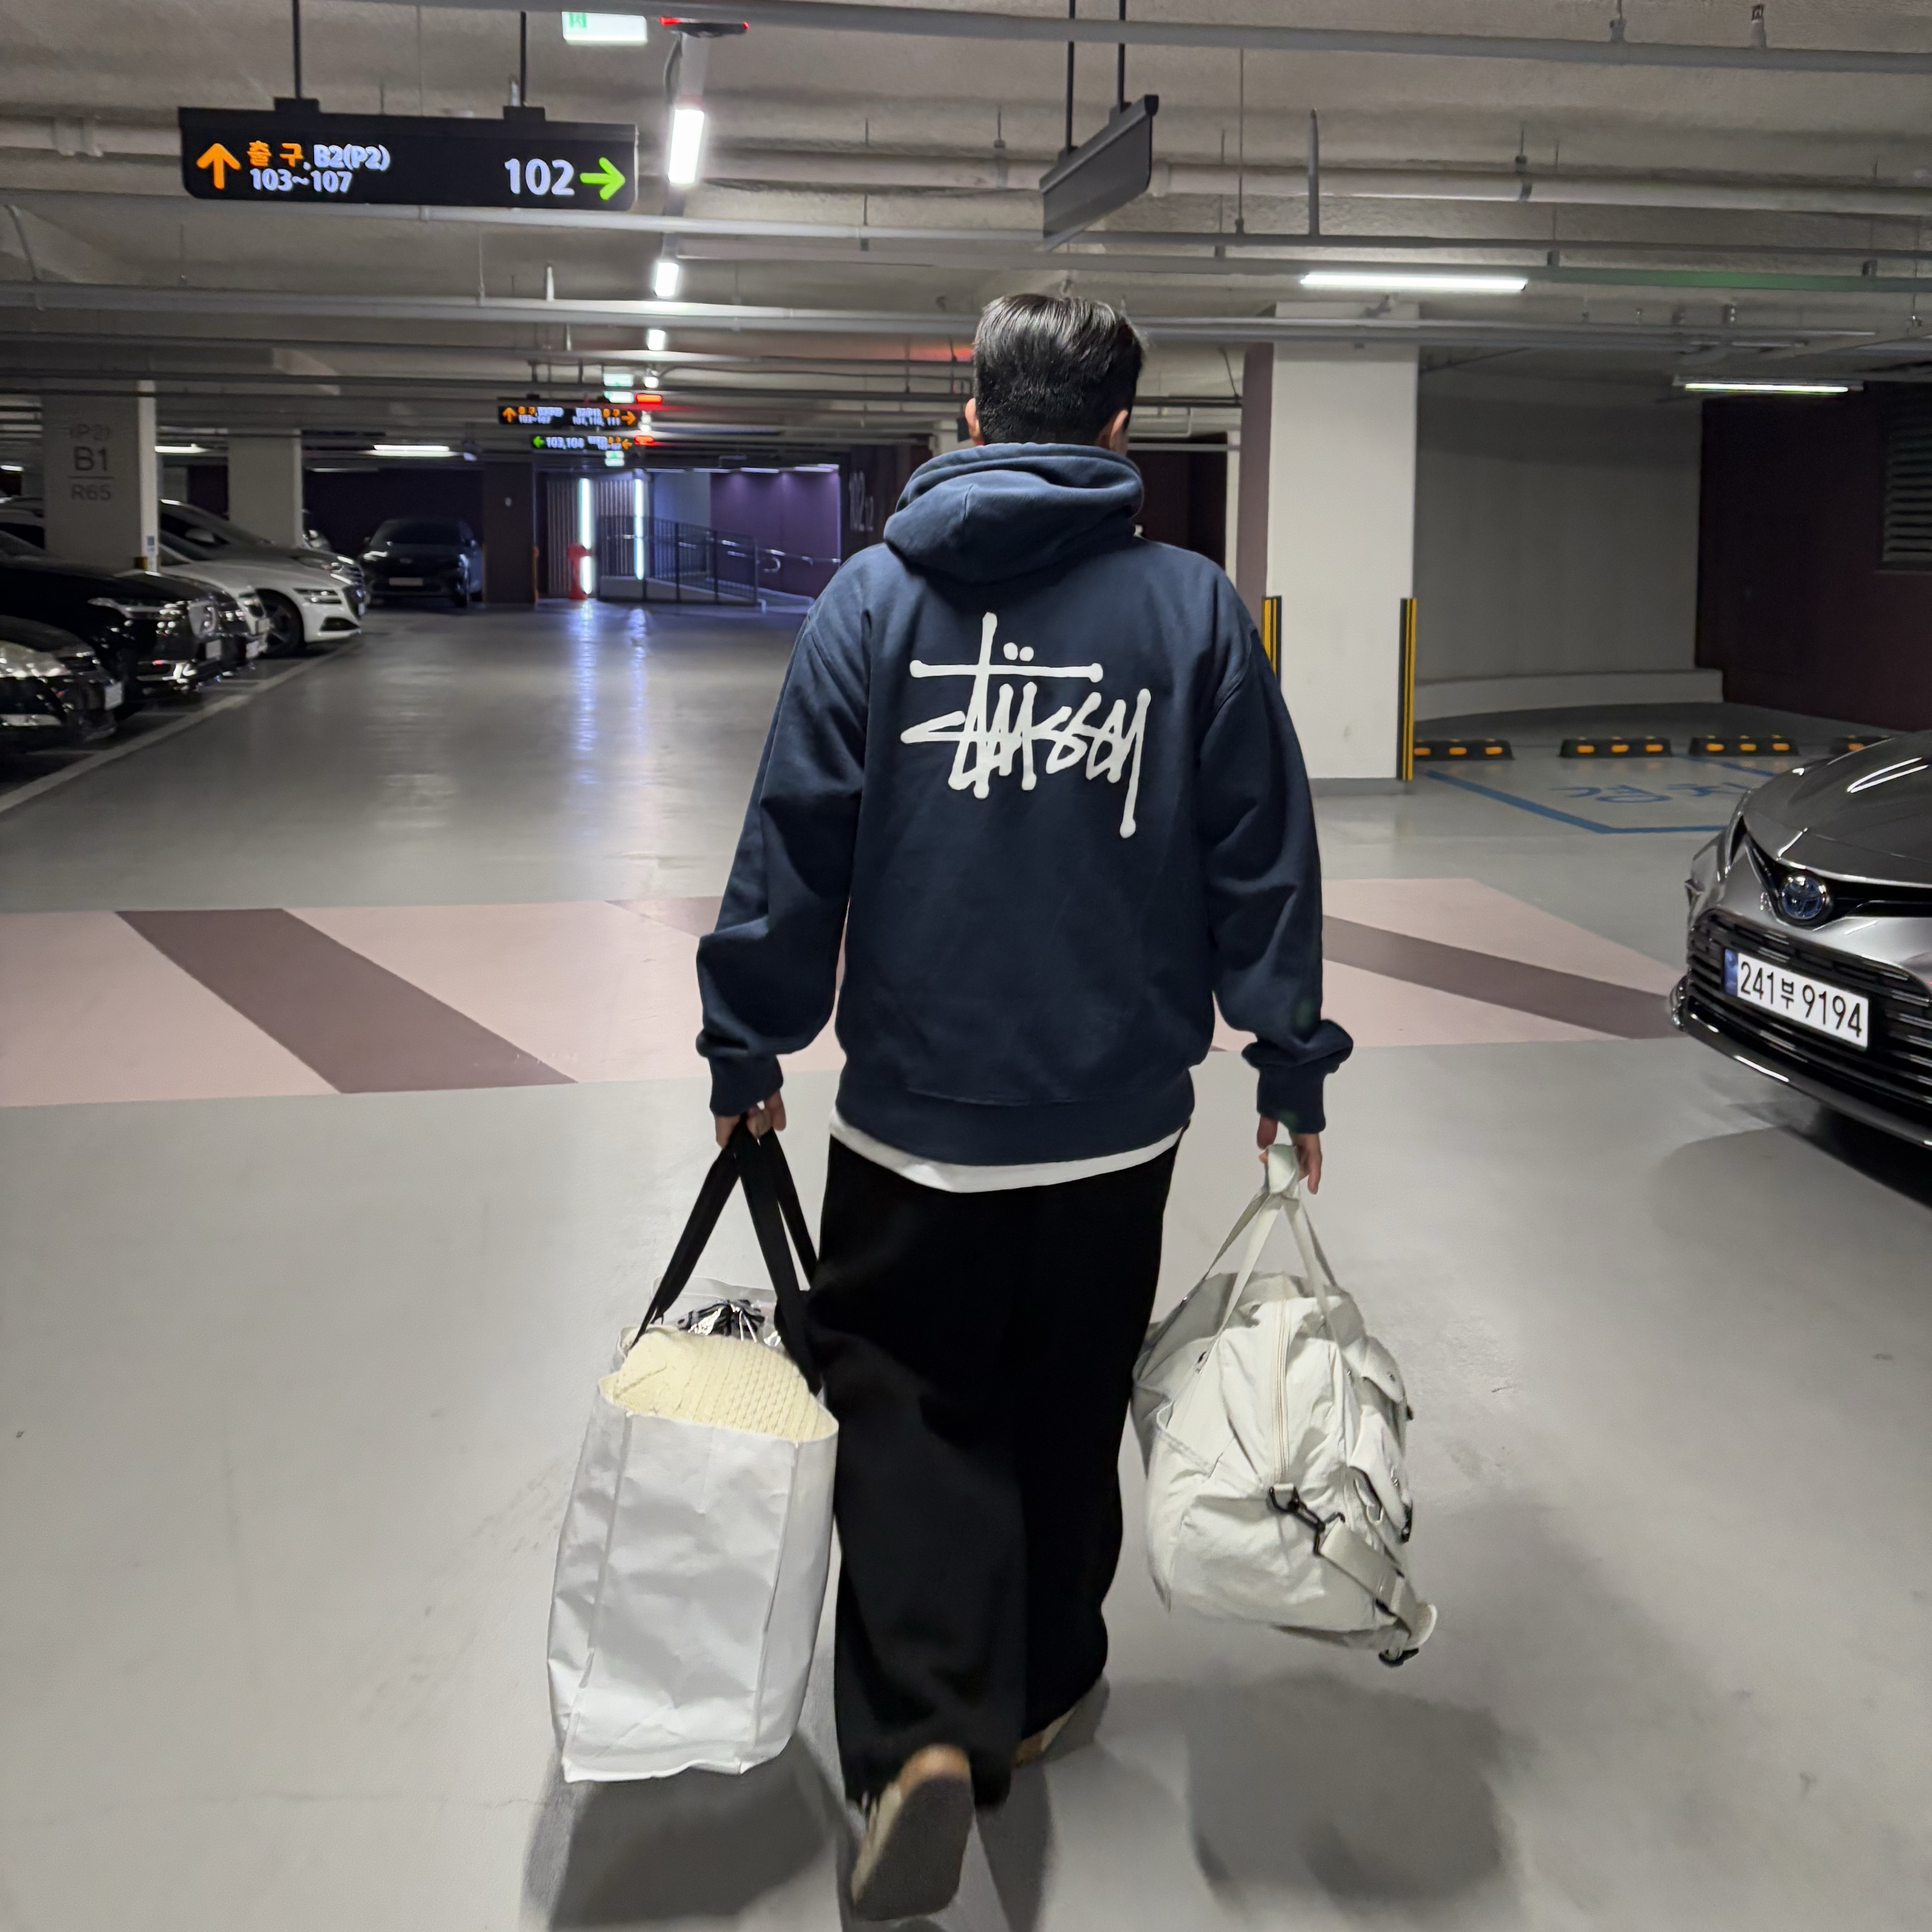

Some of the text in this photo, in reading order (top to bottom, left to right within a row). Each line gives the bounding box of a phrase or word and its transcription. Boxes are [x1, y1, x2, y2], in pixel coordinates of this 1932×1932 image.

[250, 168, 353, 192] 103~107
[504, 158, 575, 196] 102
[74, 446, 108, 471] B1
[71, 483, 112, 501] R65
[1741, 961, 1862, 1038] 241부 9194
